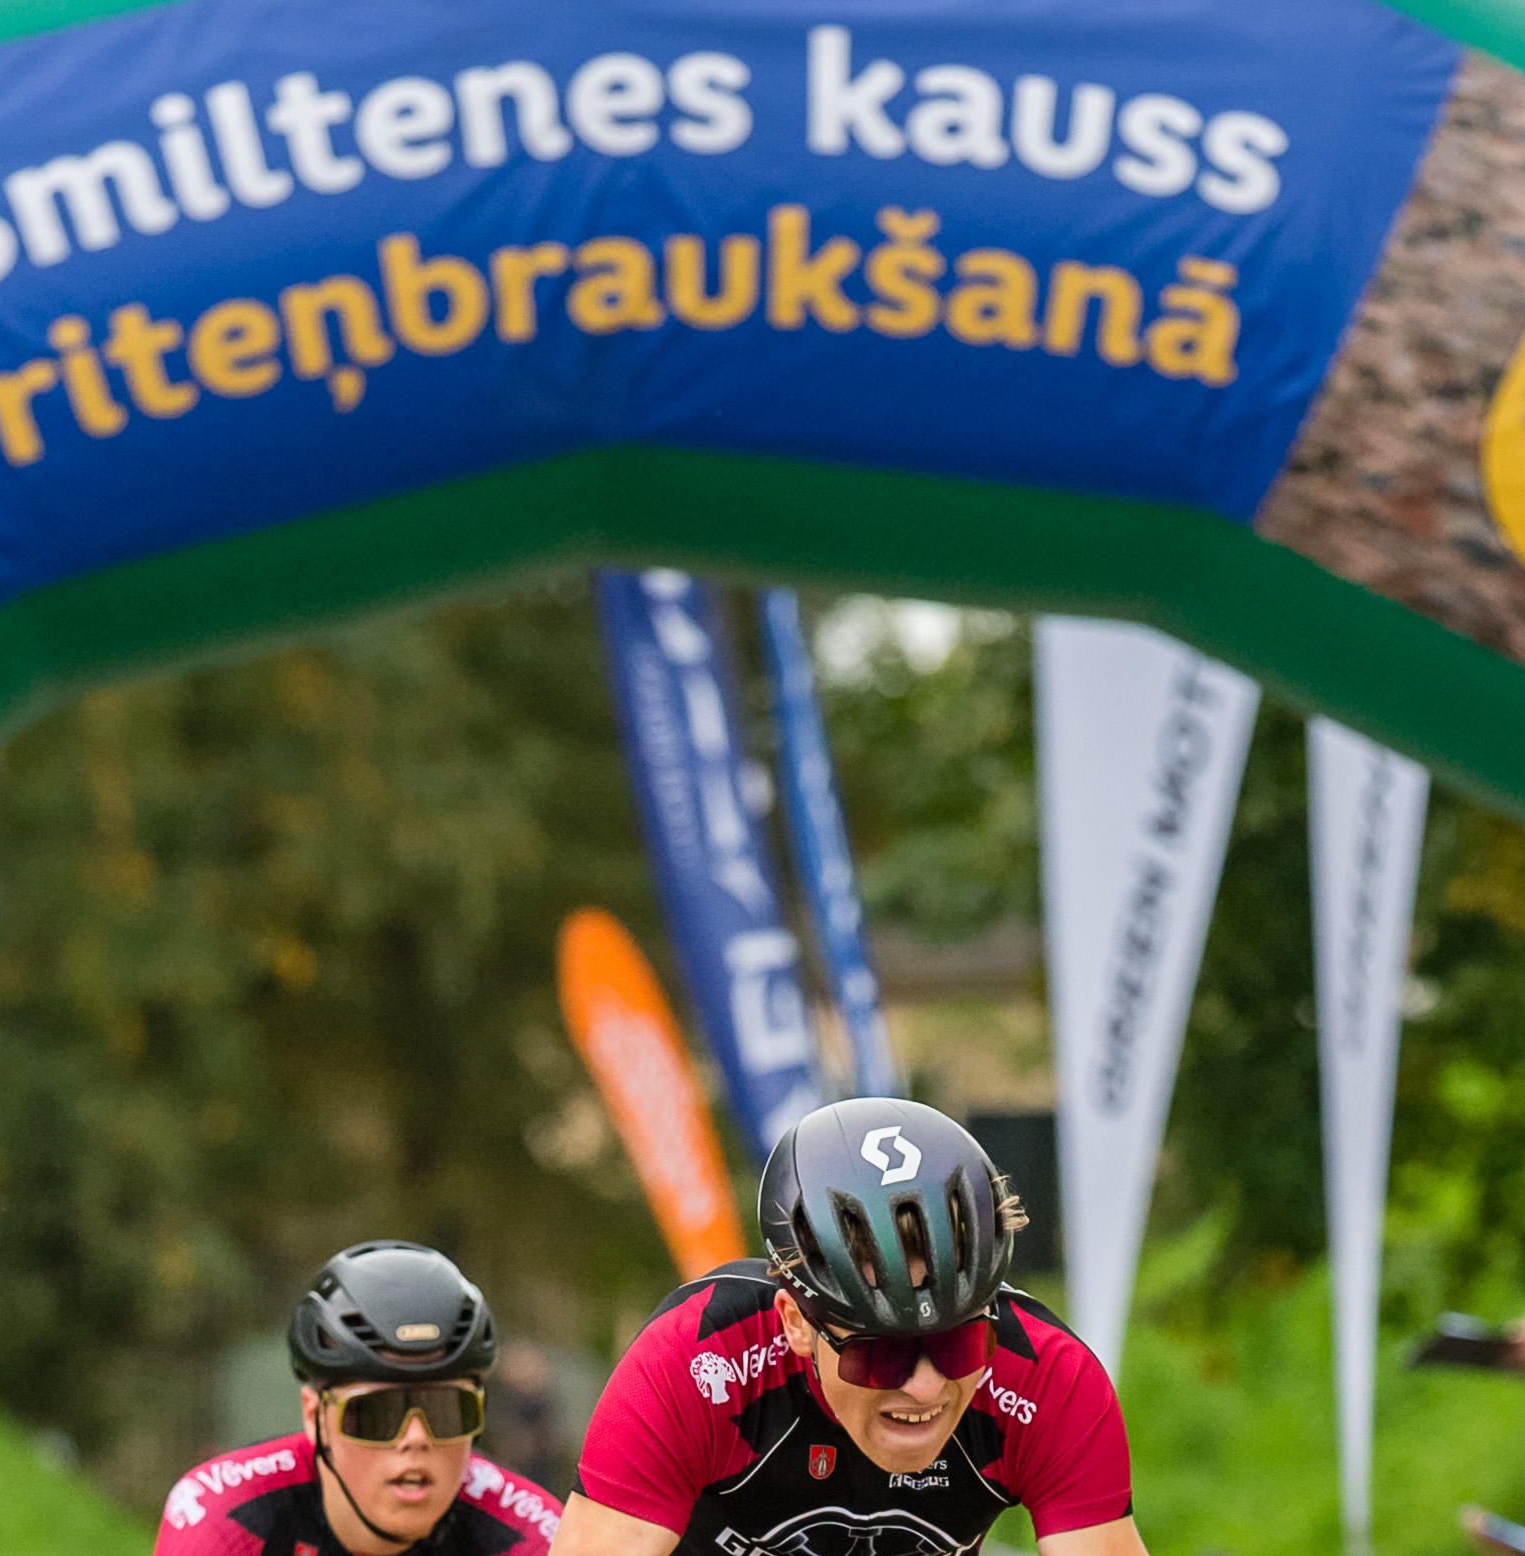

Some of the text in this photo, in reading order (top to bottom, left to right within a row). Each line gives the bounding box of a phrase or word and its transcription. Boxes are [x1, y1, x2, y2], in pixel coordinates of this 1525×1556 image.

[806, 25, 1288, 213] kauss
[196, 1449, 296, 1495] Vēvers
[500, 1481, 562, 1543] Vēve
